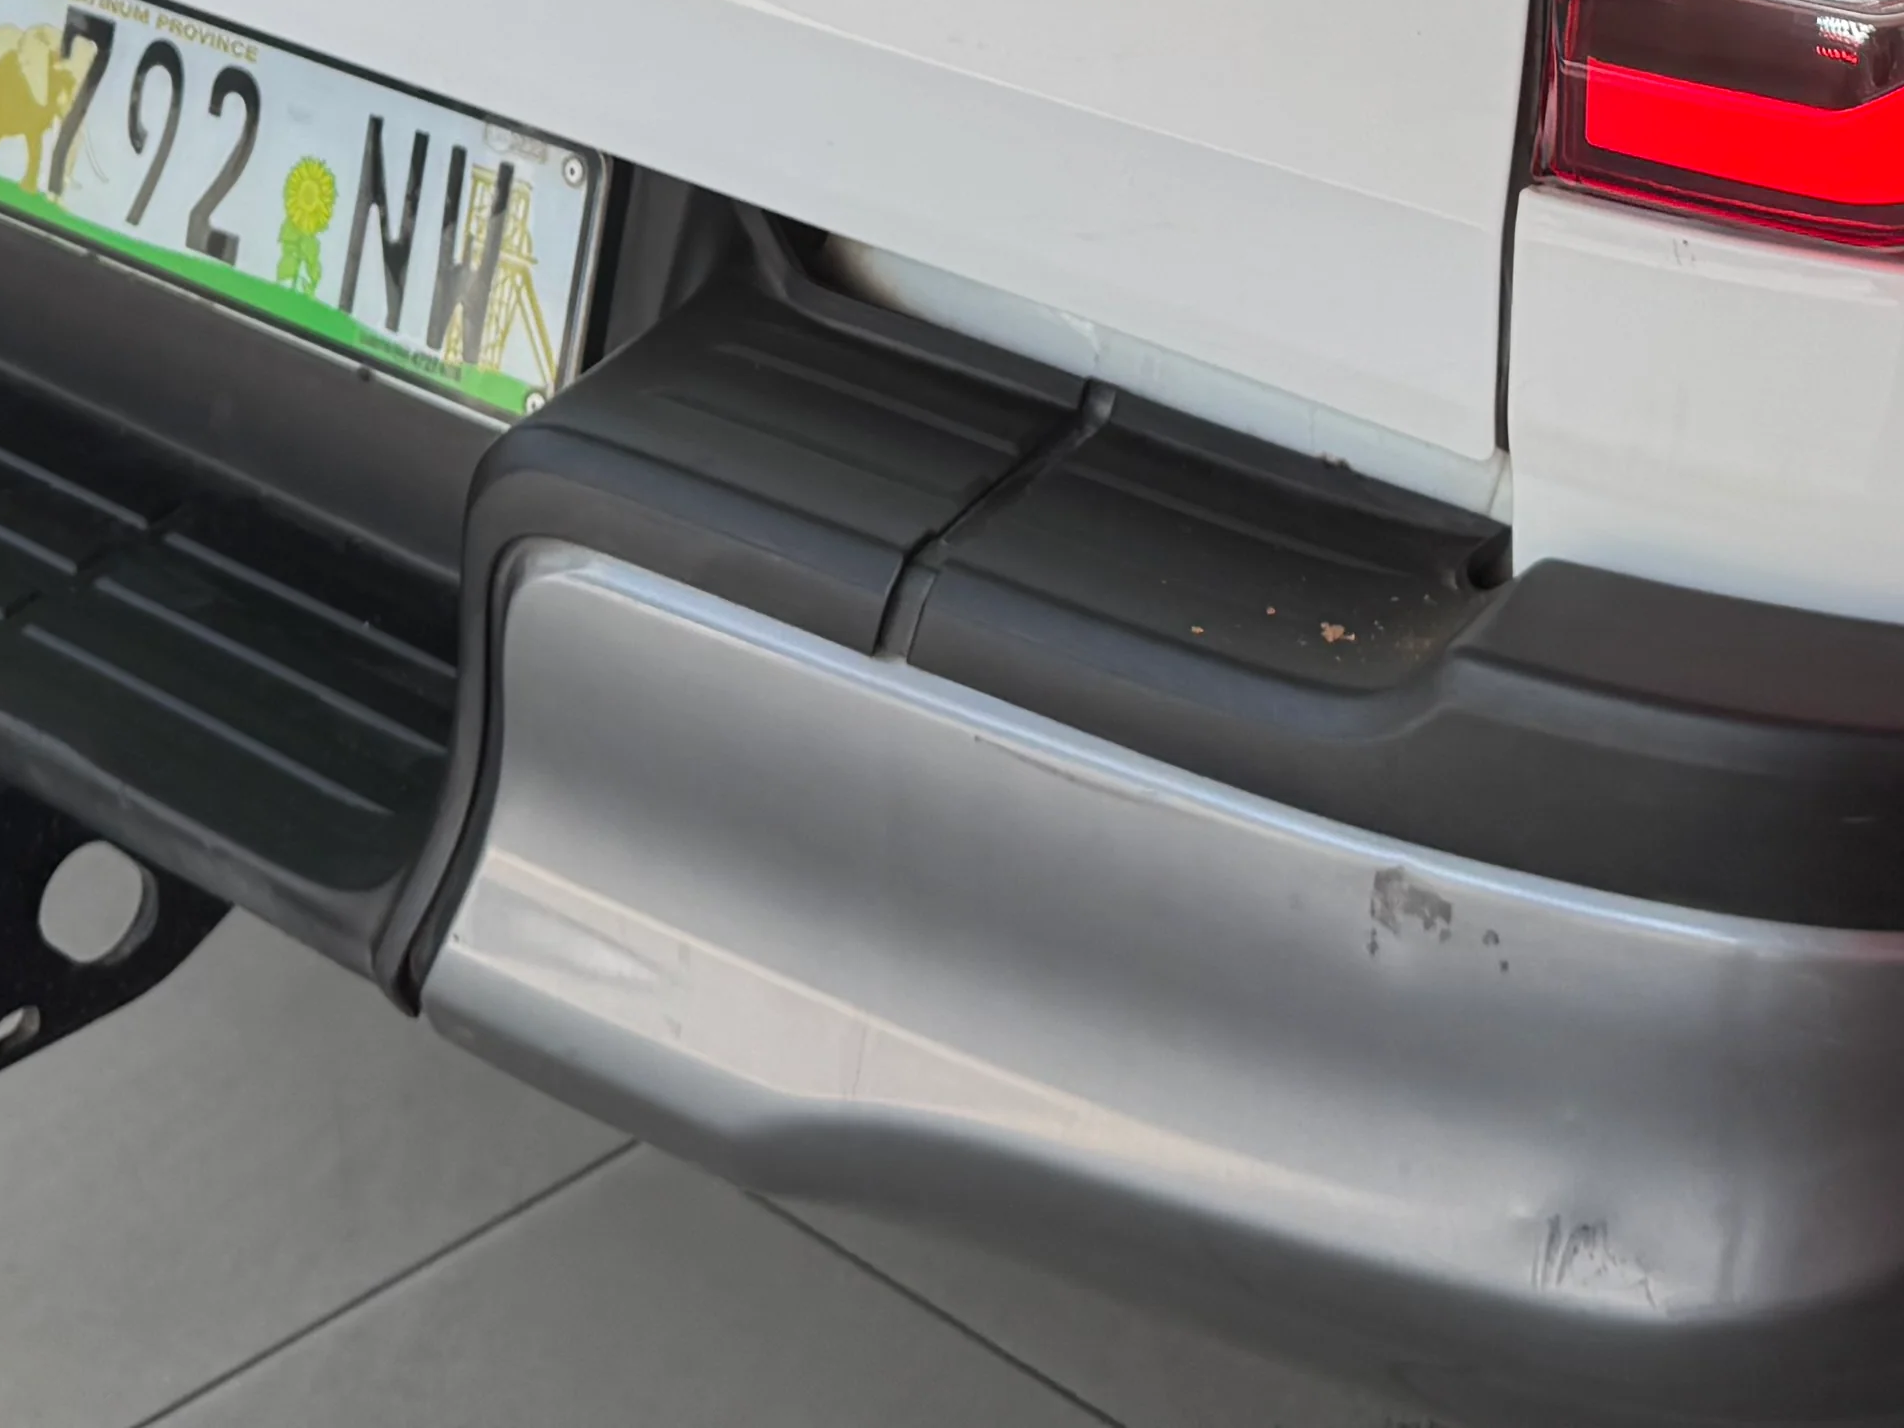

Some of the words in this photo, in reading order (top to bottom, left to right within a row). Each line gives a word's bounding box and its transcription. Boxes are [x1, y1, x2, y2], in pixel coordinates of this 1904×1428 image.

[155, 10, 260, 64] PROVINCE
[48, 5, 262, 267] 792
[338, 112, 516, 365] NW
